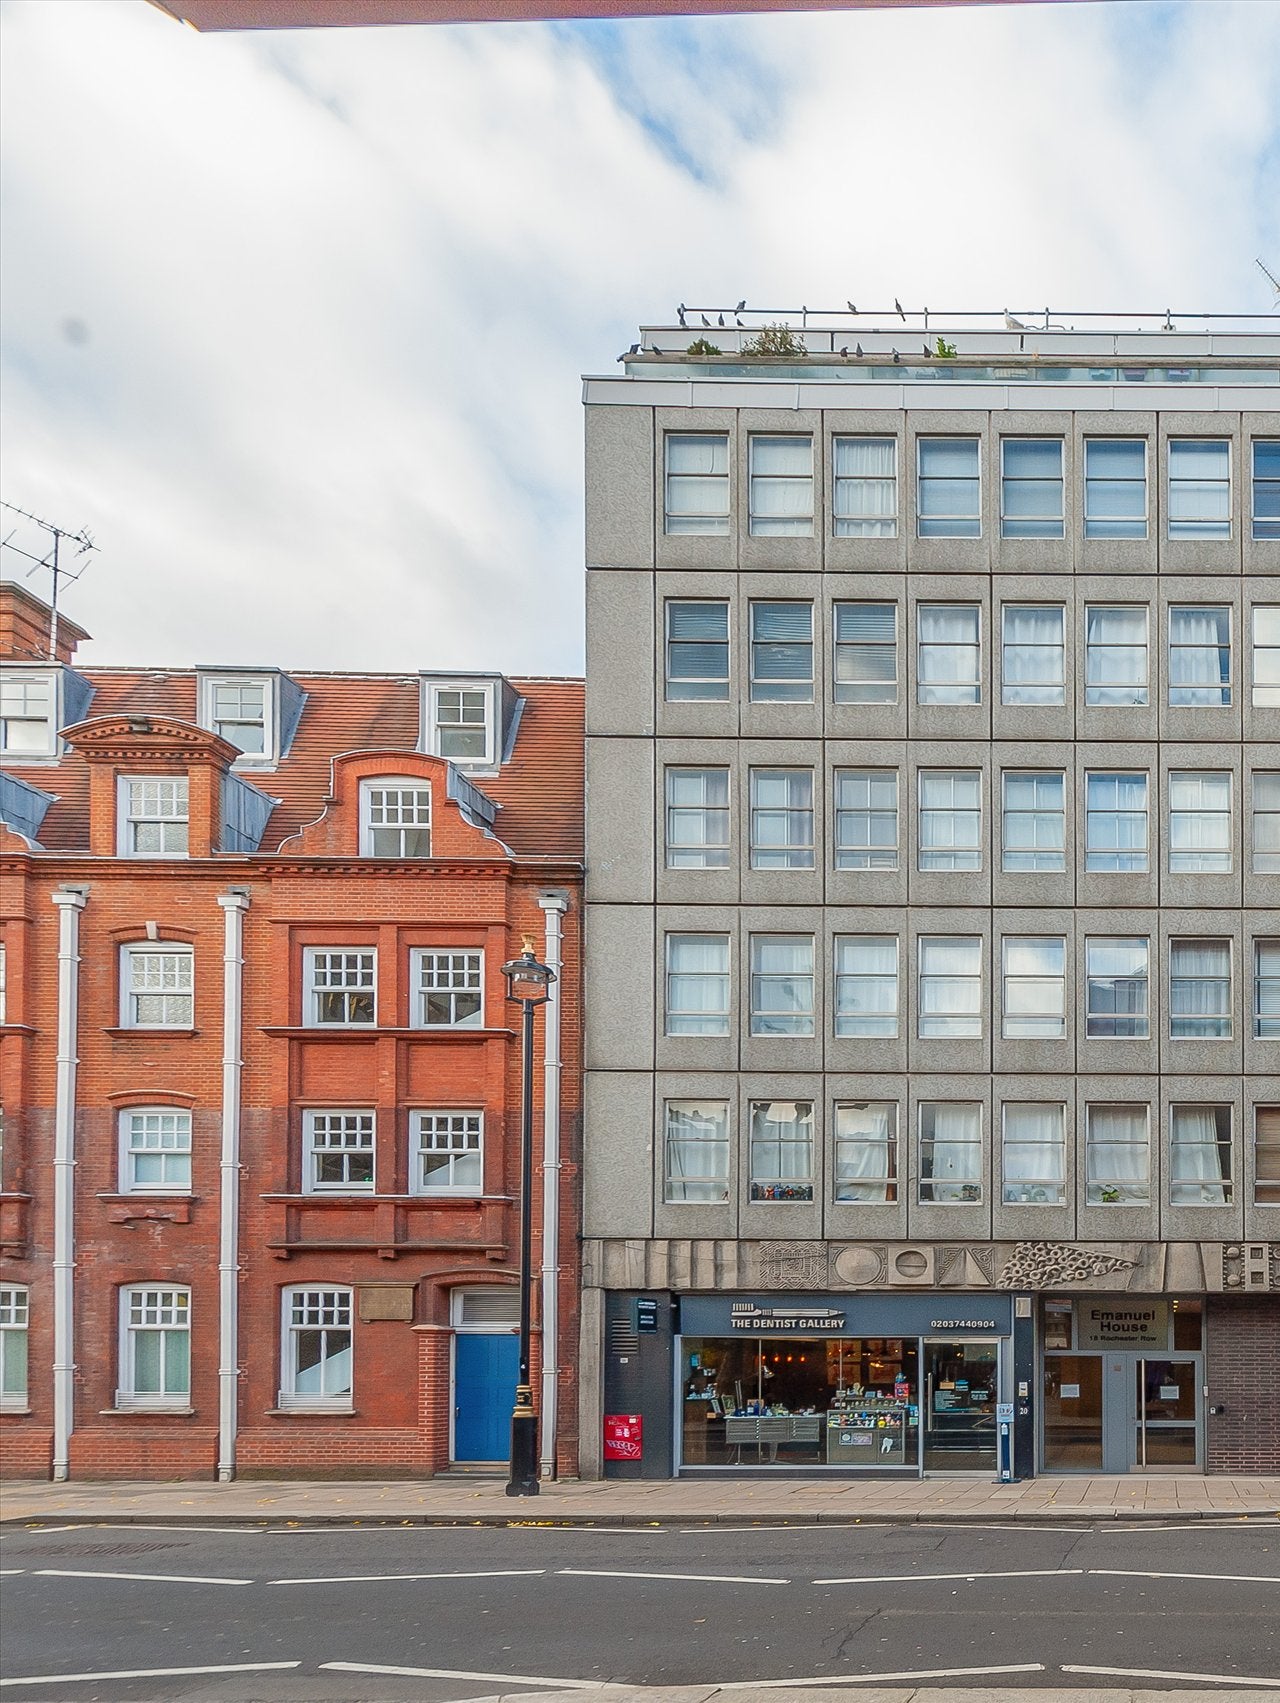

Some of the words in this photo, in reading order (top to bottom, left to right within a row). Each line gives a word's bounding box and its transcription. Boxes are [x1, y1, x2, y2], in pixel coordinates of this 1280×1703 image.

[1091, 1309, 1156, 1321] Emanuel
[731, 1319, 751, 1328] THE
[753, 1319, 797, 1328] DENTIST
[799, 1319, 845, 1328] GALLERY
[930, 1320, 995, 1328] 02037440904
[1100, 1321, 1148, 1332] House
